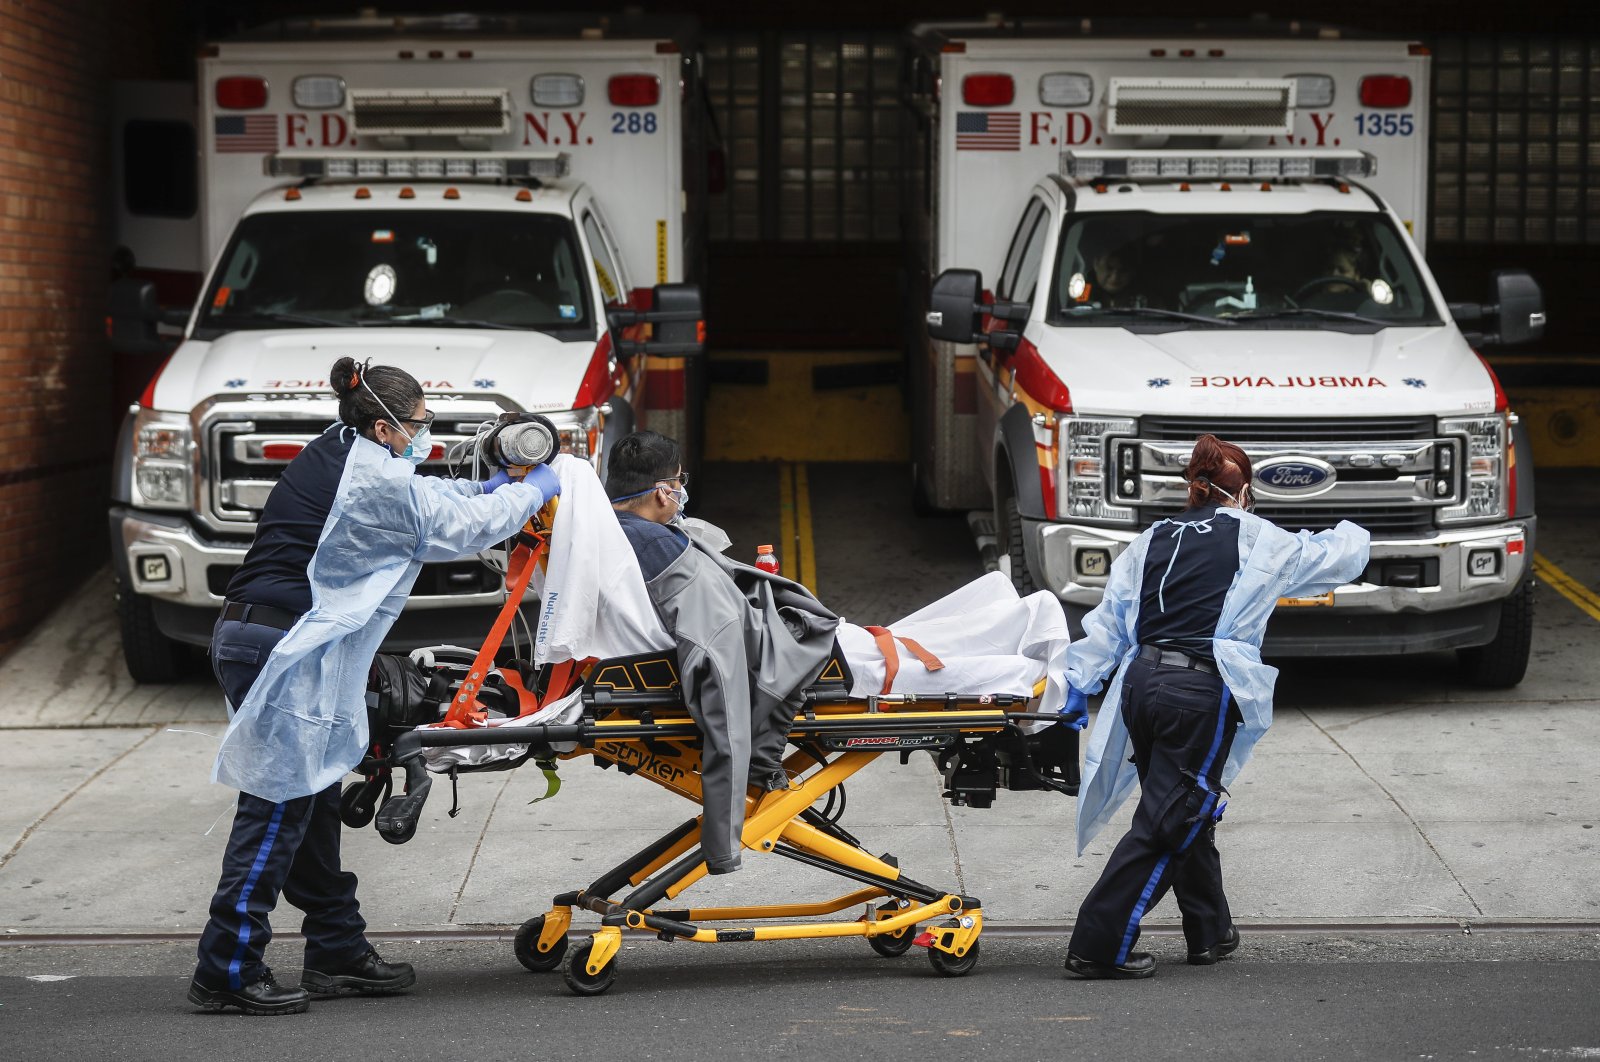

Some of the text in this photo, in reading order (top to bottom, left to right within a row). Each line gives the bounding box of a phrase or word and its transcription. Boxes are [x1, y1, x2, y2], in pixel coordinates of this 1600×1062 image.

[286, 112, 594, 147] F.D. N.Y.
[611, 112, 657, 134] 288
[1030, 112, 1102, 146] F.D.
[1354, 113, 1414, 136] 1355
[1271, 466, 1313, 484] Ford
[538, 591, 559, 643] NuHealth
[600, 741, 684, 782] stryker
